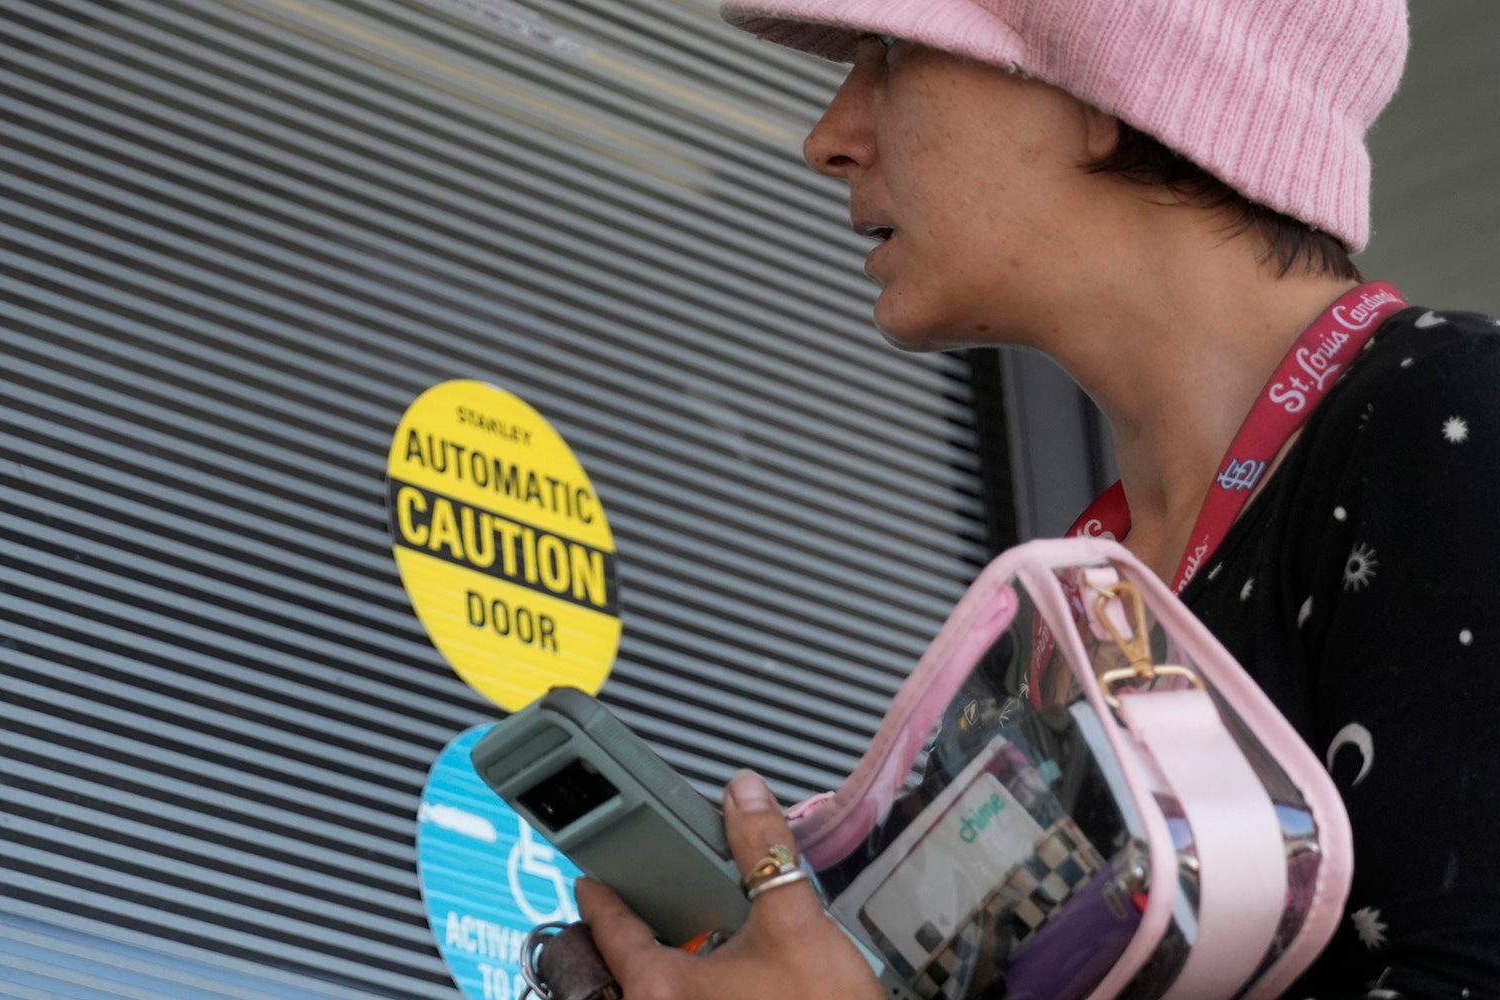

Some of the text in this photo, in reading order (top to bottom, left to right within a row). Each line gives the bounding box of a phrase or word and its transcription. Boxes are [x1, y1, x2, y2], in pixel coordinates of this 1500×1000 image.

[1296, 331, 1349, 391] Louis
[456, 406, 532, 446] STANLEY
[405, 428, 594, 525] AUTOMATIC
[396, 485, 608, 608] CAUTION
[466, 589, 560, 653] DOOR
[446, 911, 526, 965] ACTIVA
